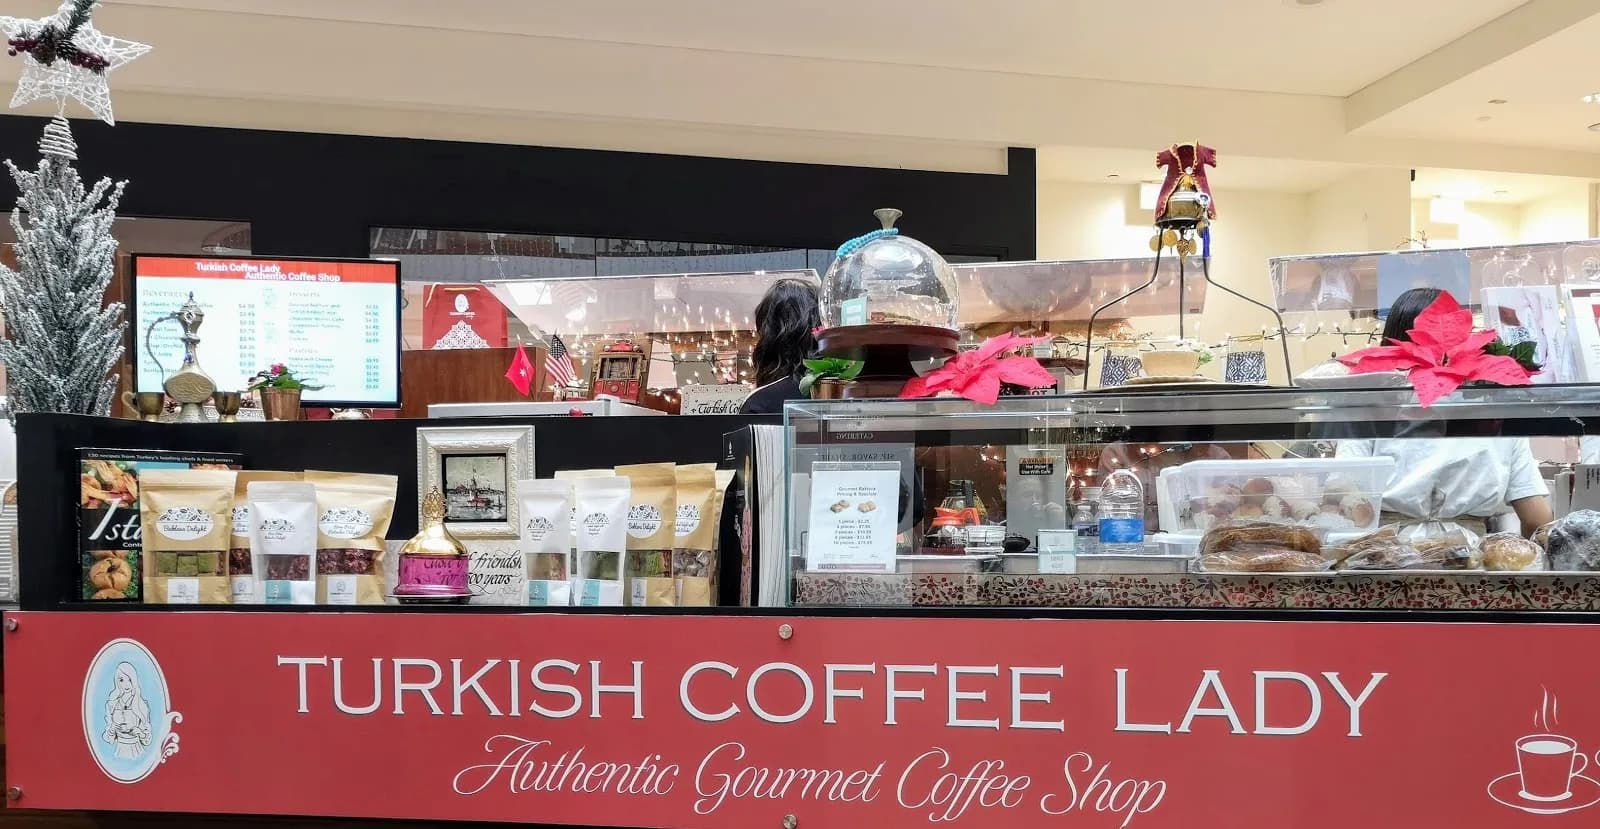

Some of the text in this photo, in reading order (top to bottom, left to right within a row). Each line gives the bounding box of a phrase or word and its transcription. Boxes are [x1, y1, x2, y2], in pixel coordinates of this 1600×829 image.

[195, 262, 280, 275] Turkish Coffee Lady
[245, 271, 341, 283] Authentic Coffee Shop
[697, 399, 731, 415] Turkish
[474, 550, 522, 576] friendsh
[484, 572, 515, 591] years
[277, 655, 1389, 737] TURKISH COFFEE LADY
[452, 734, 1167, 829] Authentic Gourmet Coffee Shop
